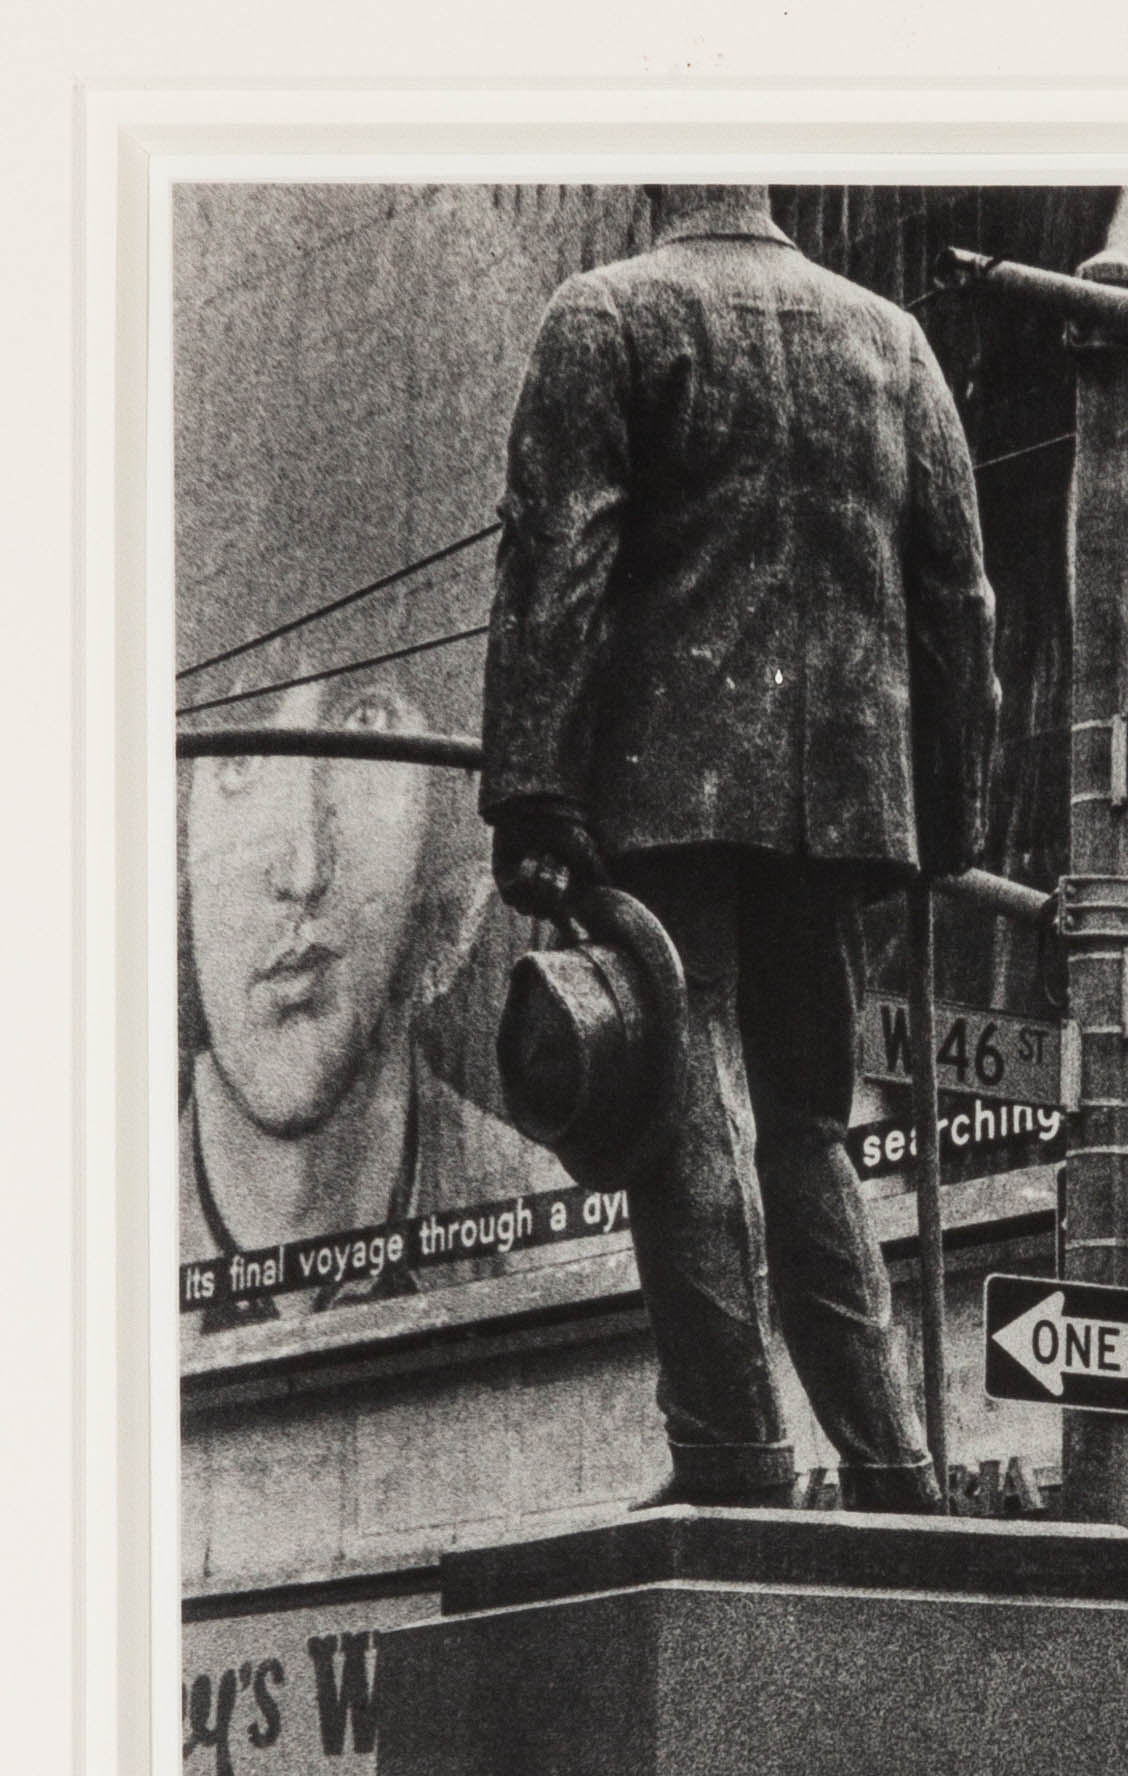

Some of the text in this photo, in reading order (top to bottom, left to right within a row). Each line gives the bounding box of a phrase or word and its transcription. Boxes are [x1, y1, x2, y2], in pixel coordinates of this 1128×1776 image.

[881, 1004, 1049, 1085] W 46 ST
[230, 1245, 284, 1286] final
[300, 1231, 404, 1280] voyage
[419, 1196, 532, 1253] through
[551, 1202, 568, 1231] a
[1032, 1320, 1121, 1371] ONE
